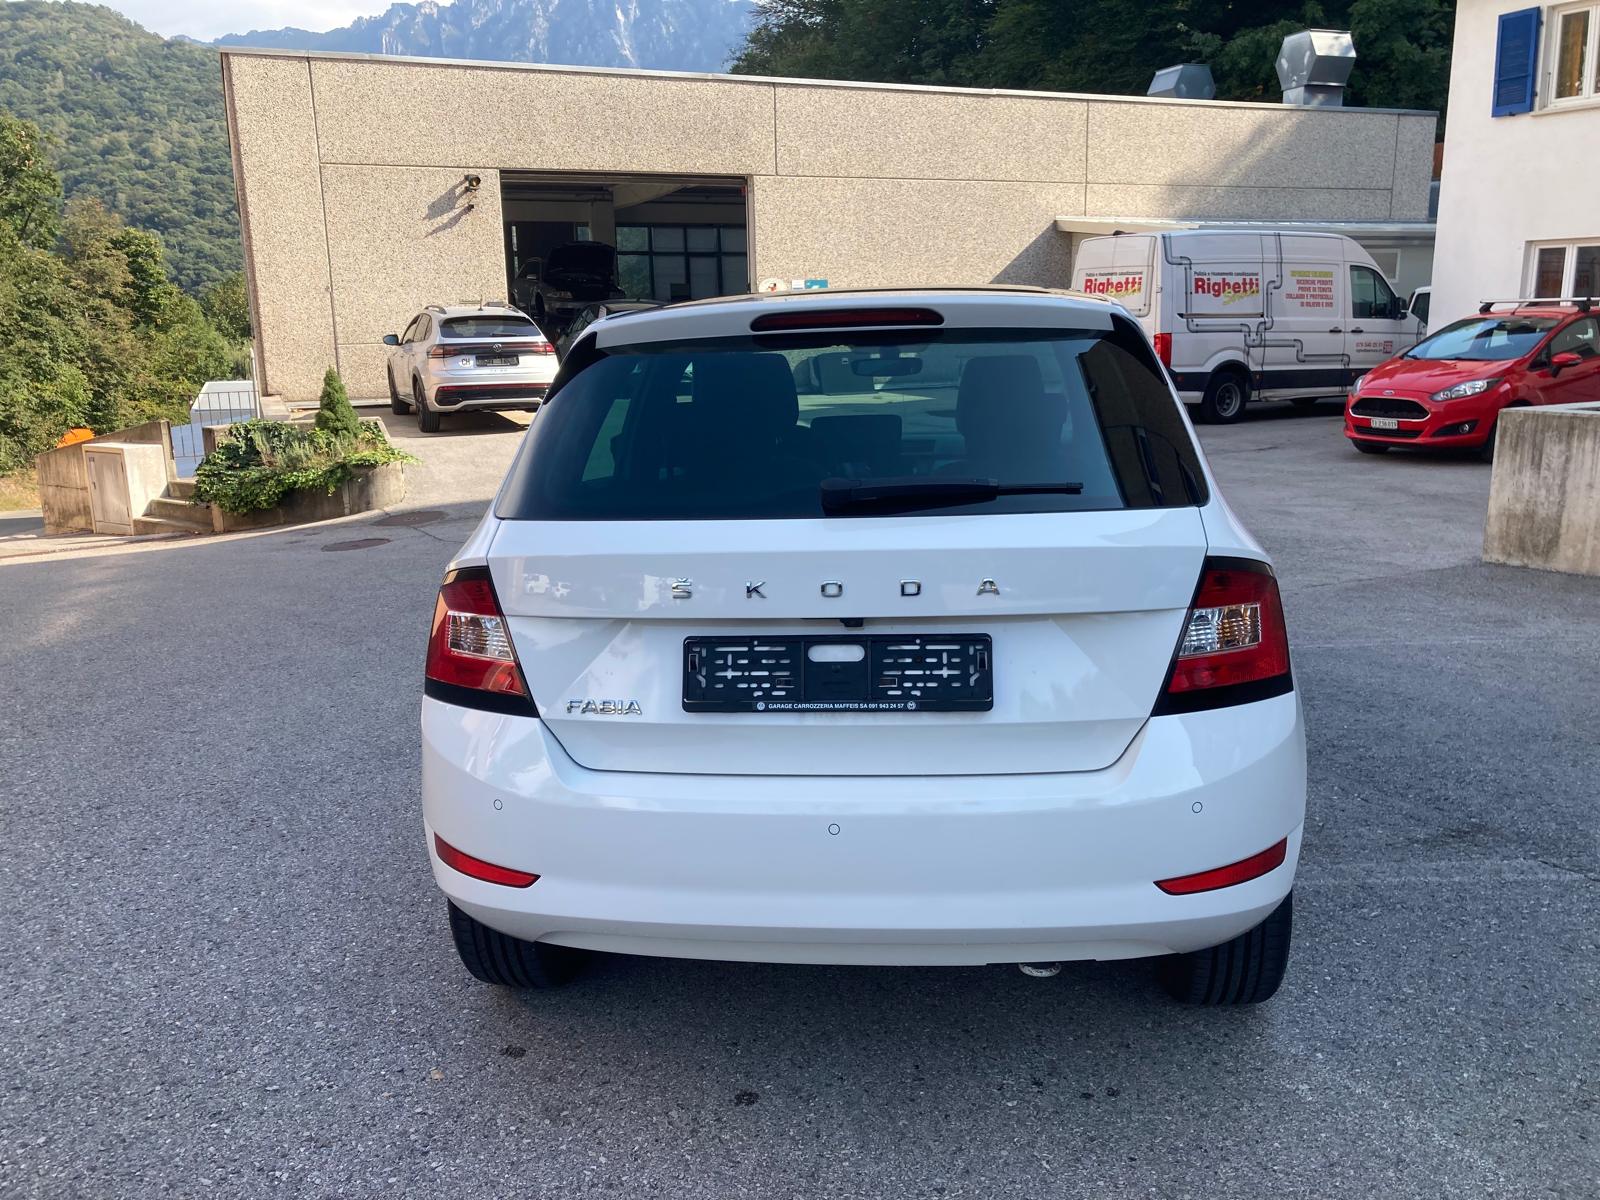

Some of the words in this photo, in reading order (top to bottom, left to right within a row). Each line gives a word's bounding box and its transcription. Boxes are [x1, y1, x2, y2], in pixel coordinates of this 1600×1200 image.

[1084, 277, 1143, 294] Righetti
[1194, 278, 1260, 298] Righetti
[672, 577, 1000, 599] ŠKODA
[567, 699, 643, 715] FABIA
